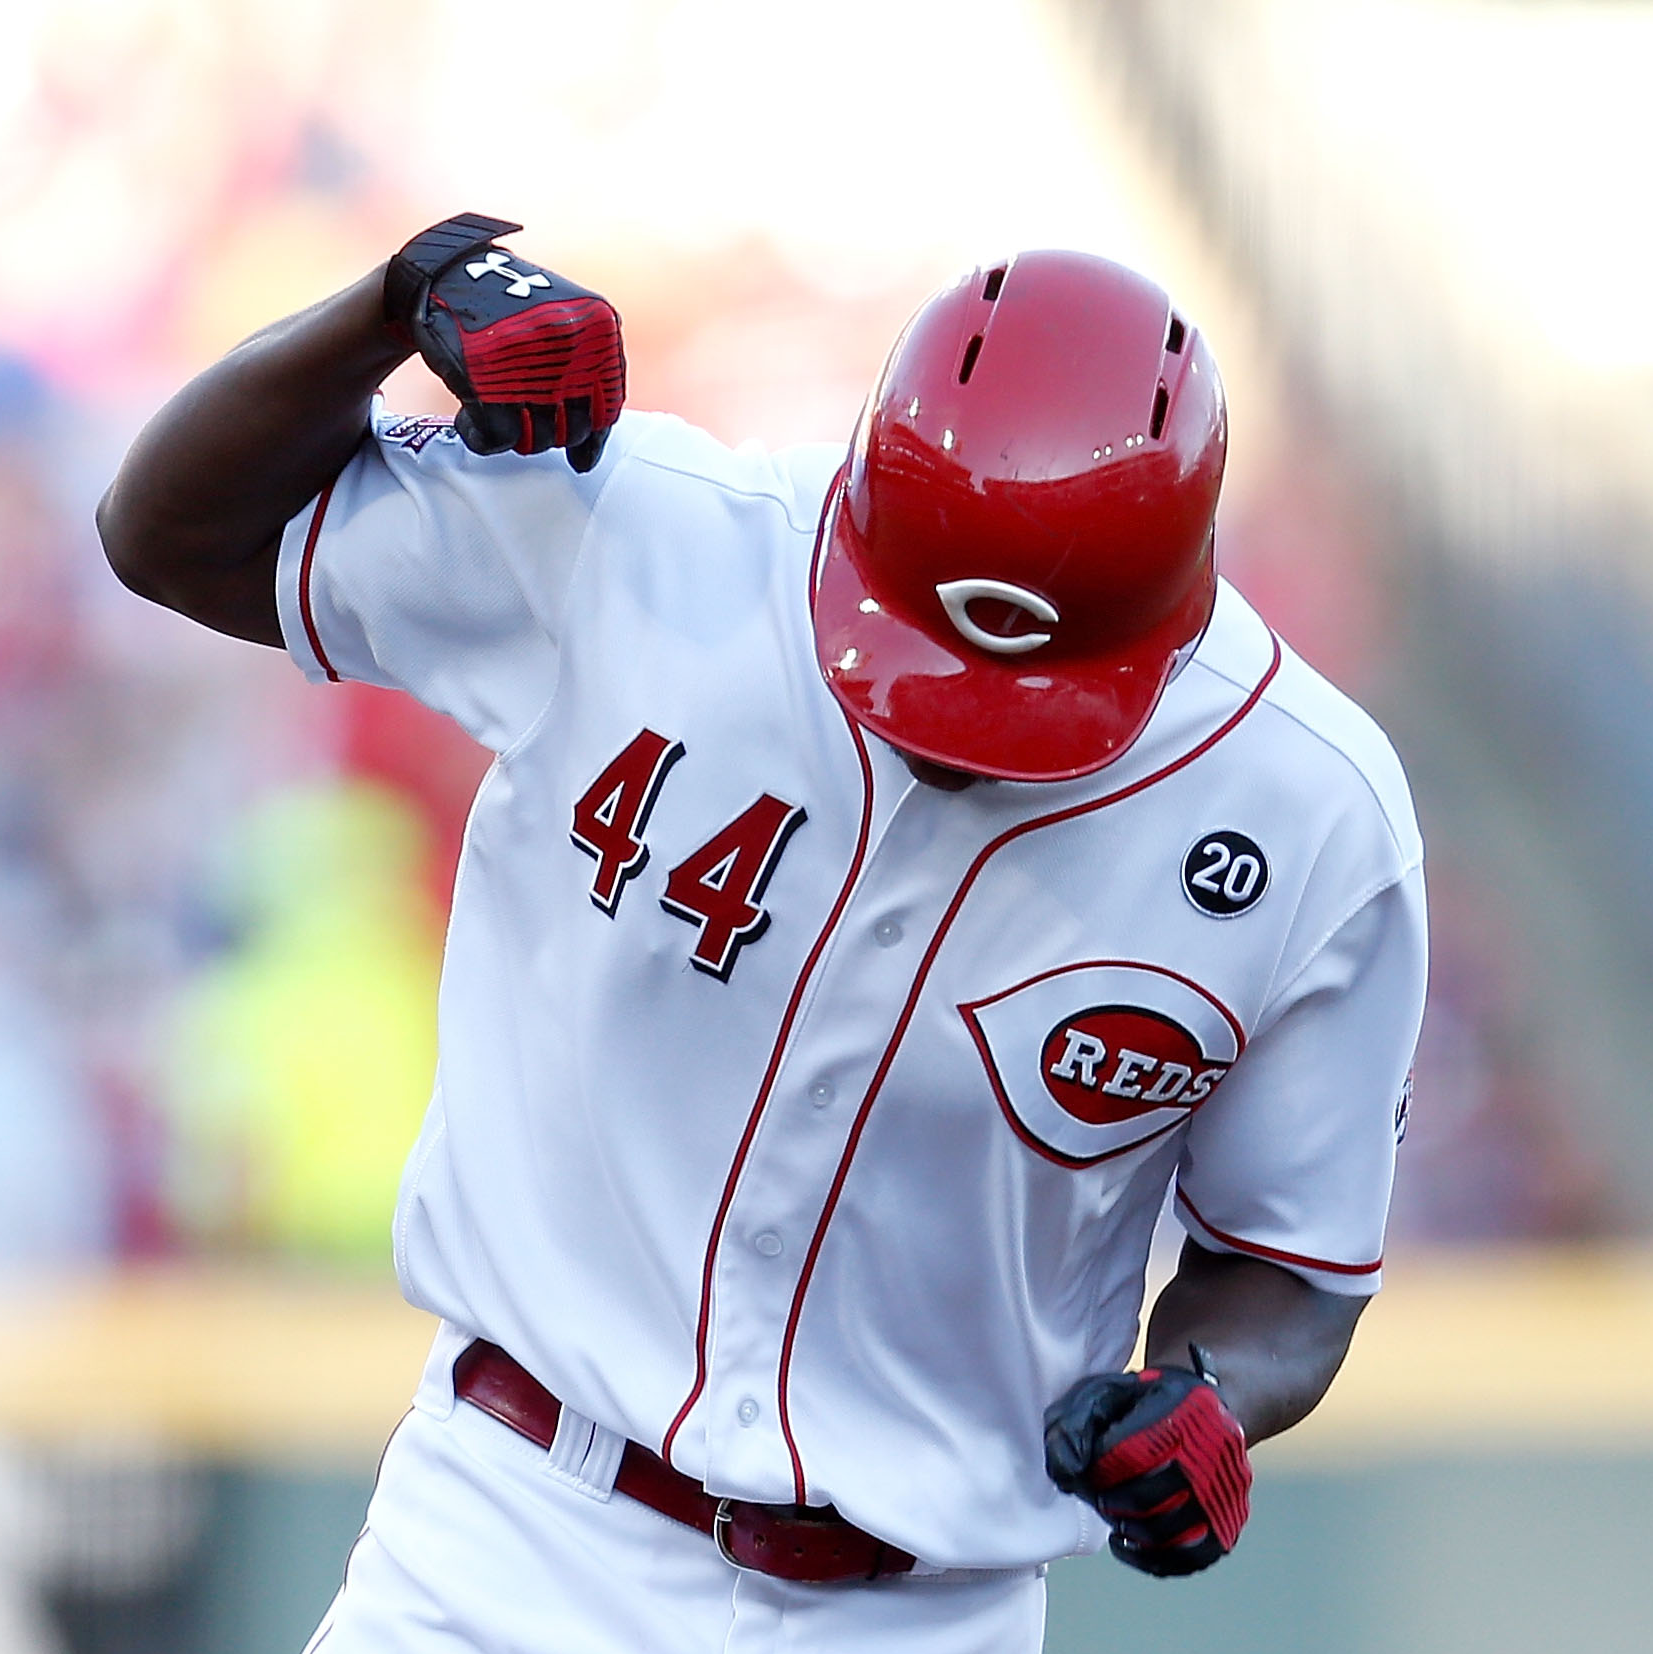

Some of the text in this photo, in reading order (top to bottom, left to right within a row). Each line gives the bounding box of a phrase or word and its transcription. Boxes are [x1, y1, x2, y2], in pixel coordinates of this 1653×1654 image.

[936, 578, 1060, 654] C
[569, 727, 809, 985] 44
[1191, 842, 1260, 902] 20
[1050, 1028, 1227, 1103] REDS
